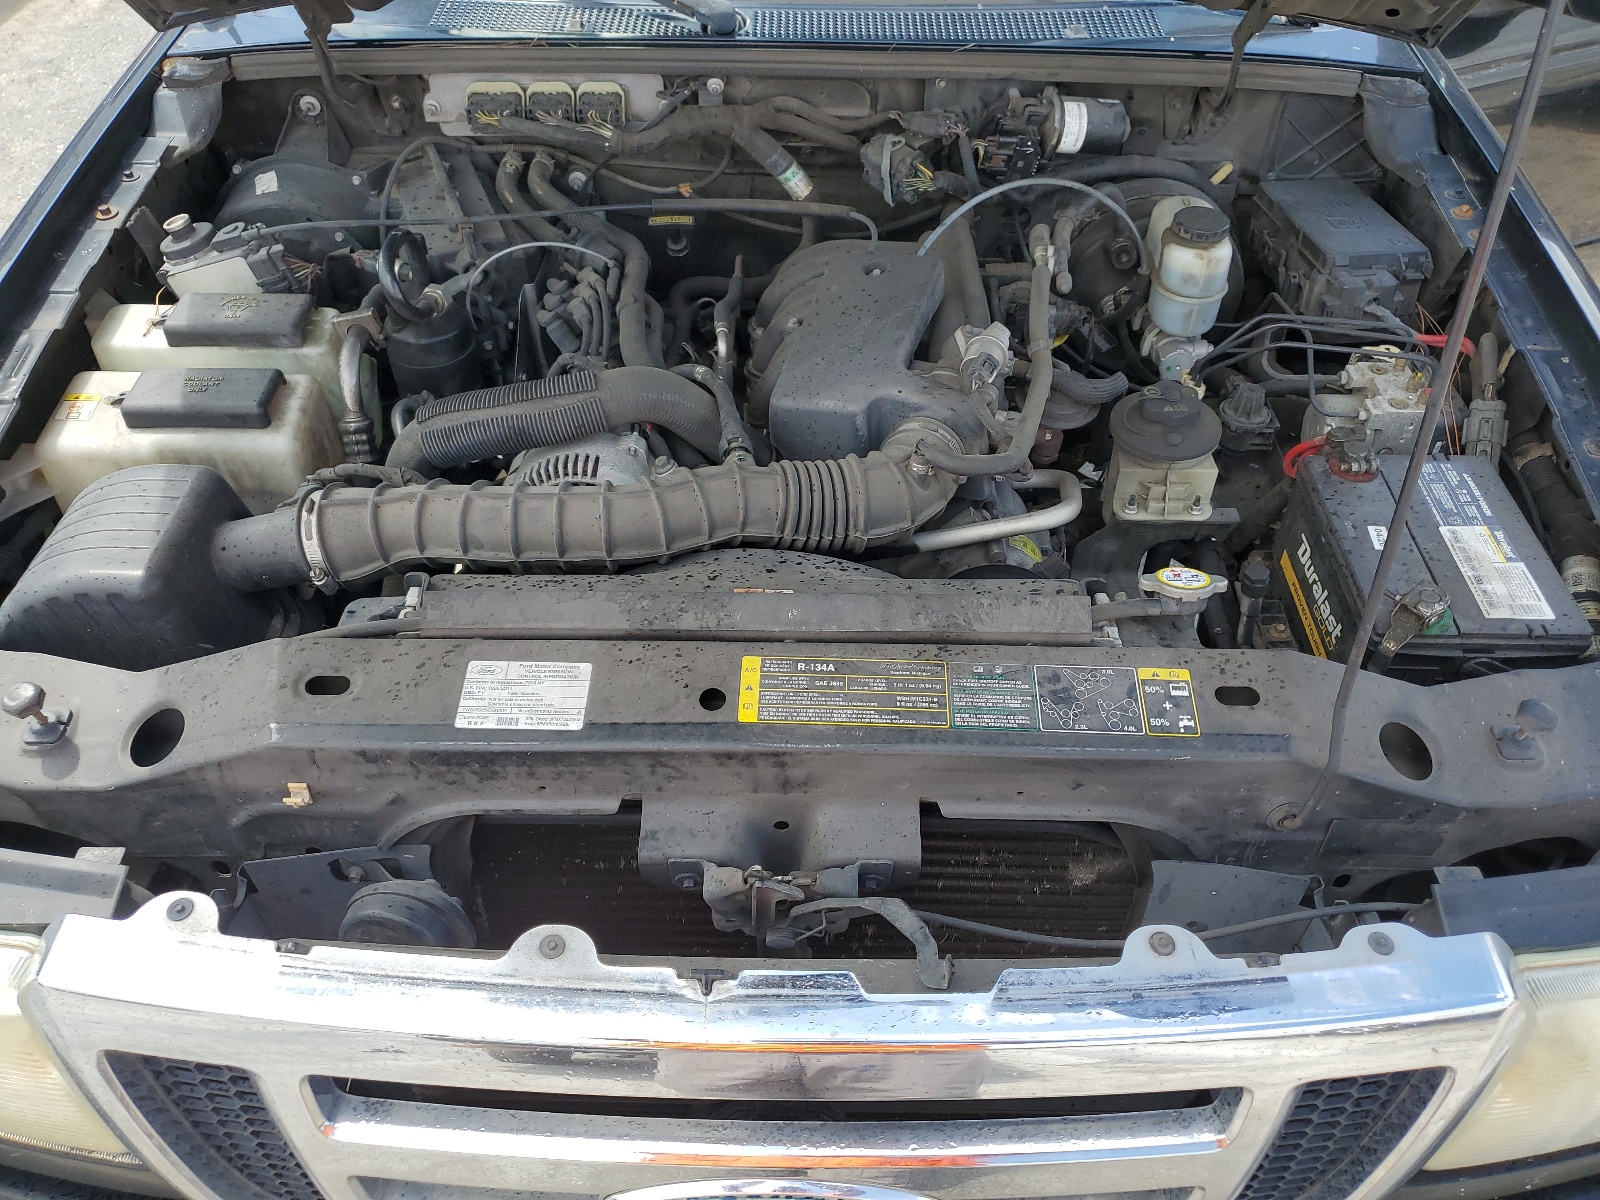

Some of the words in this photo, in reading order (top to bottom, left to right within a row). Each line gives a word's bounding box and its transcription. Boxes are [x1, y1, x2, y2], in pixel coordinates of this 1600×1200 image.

[1297, 532, 1343, 645] Duralast
[1292, 582, 1308, 621] PROVEN
[1307, 622, 1322, 657] TOUGH
[1313, 604, 1334, 652] GOLD
[797, 662, 835, 672] R-134A
[1145, 685, 1165, 694] 50%
[1150, 718, 1170, 726] 50%
